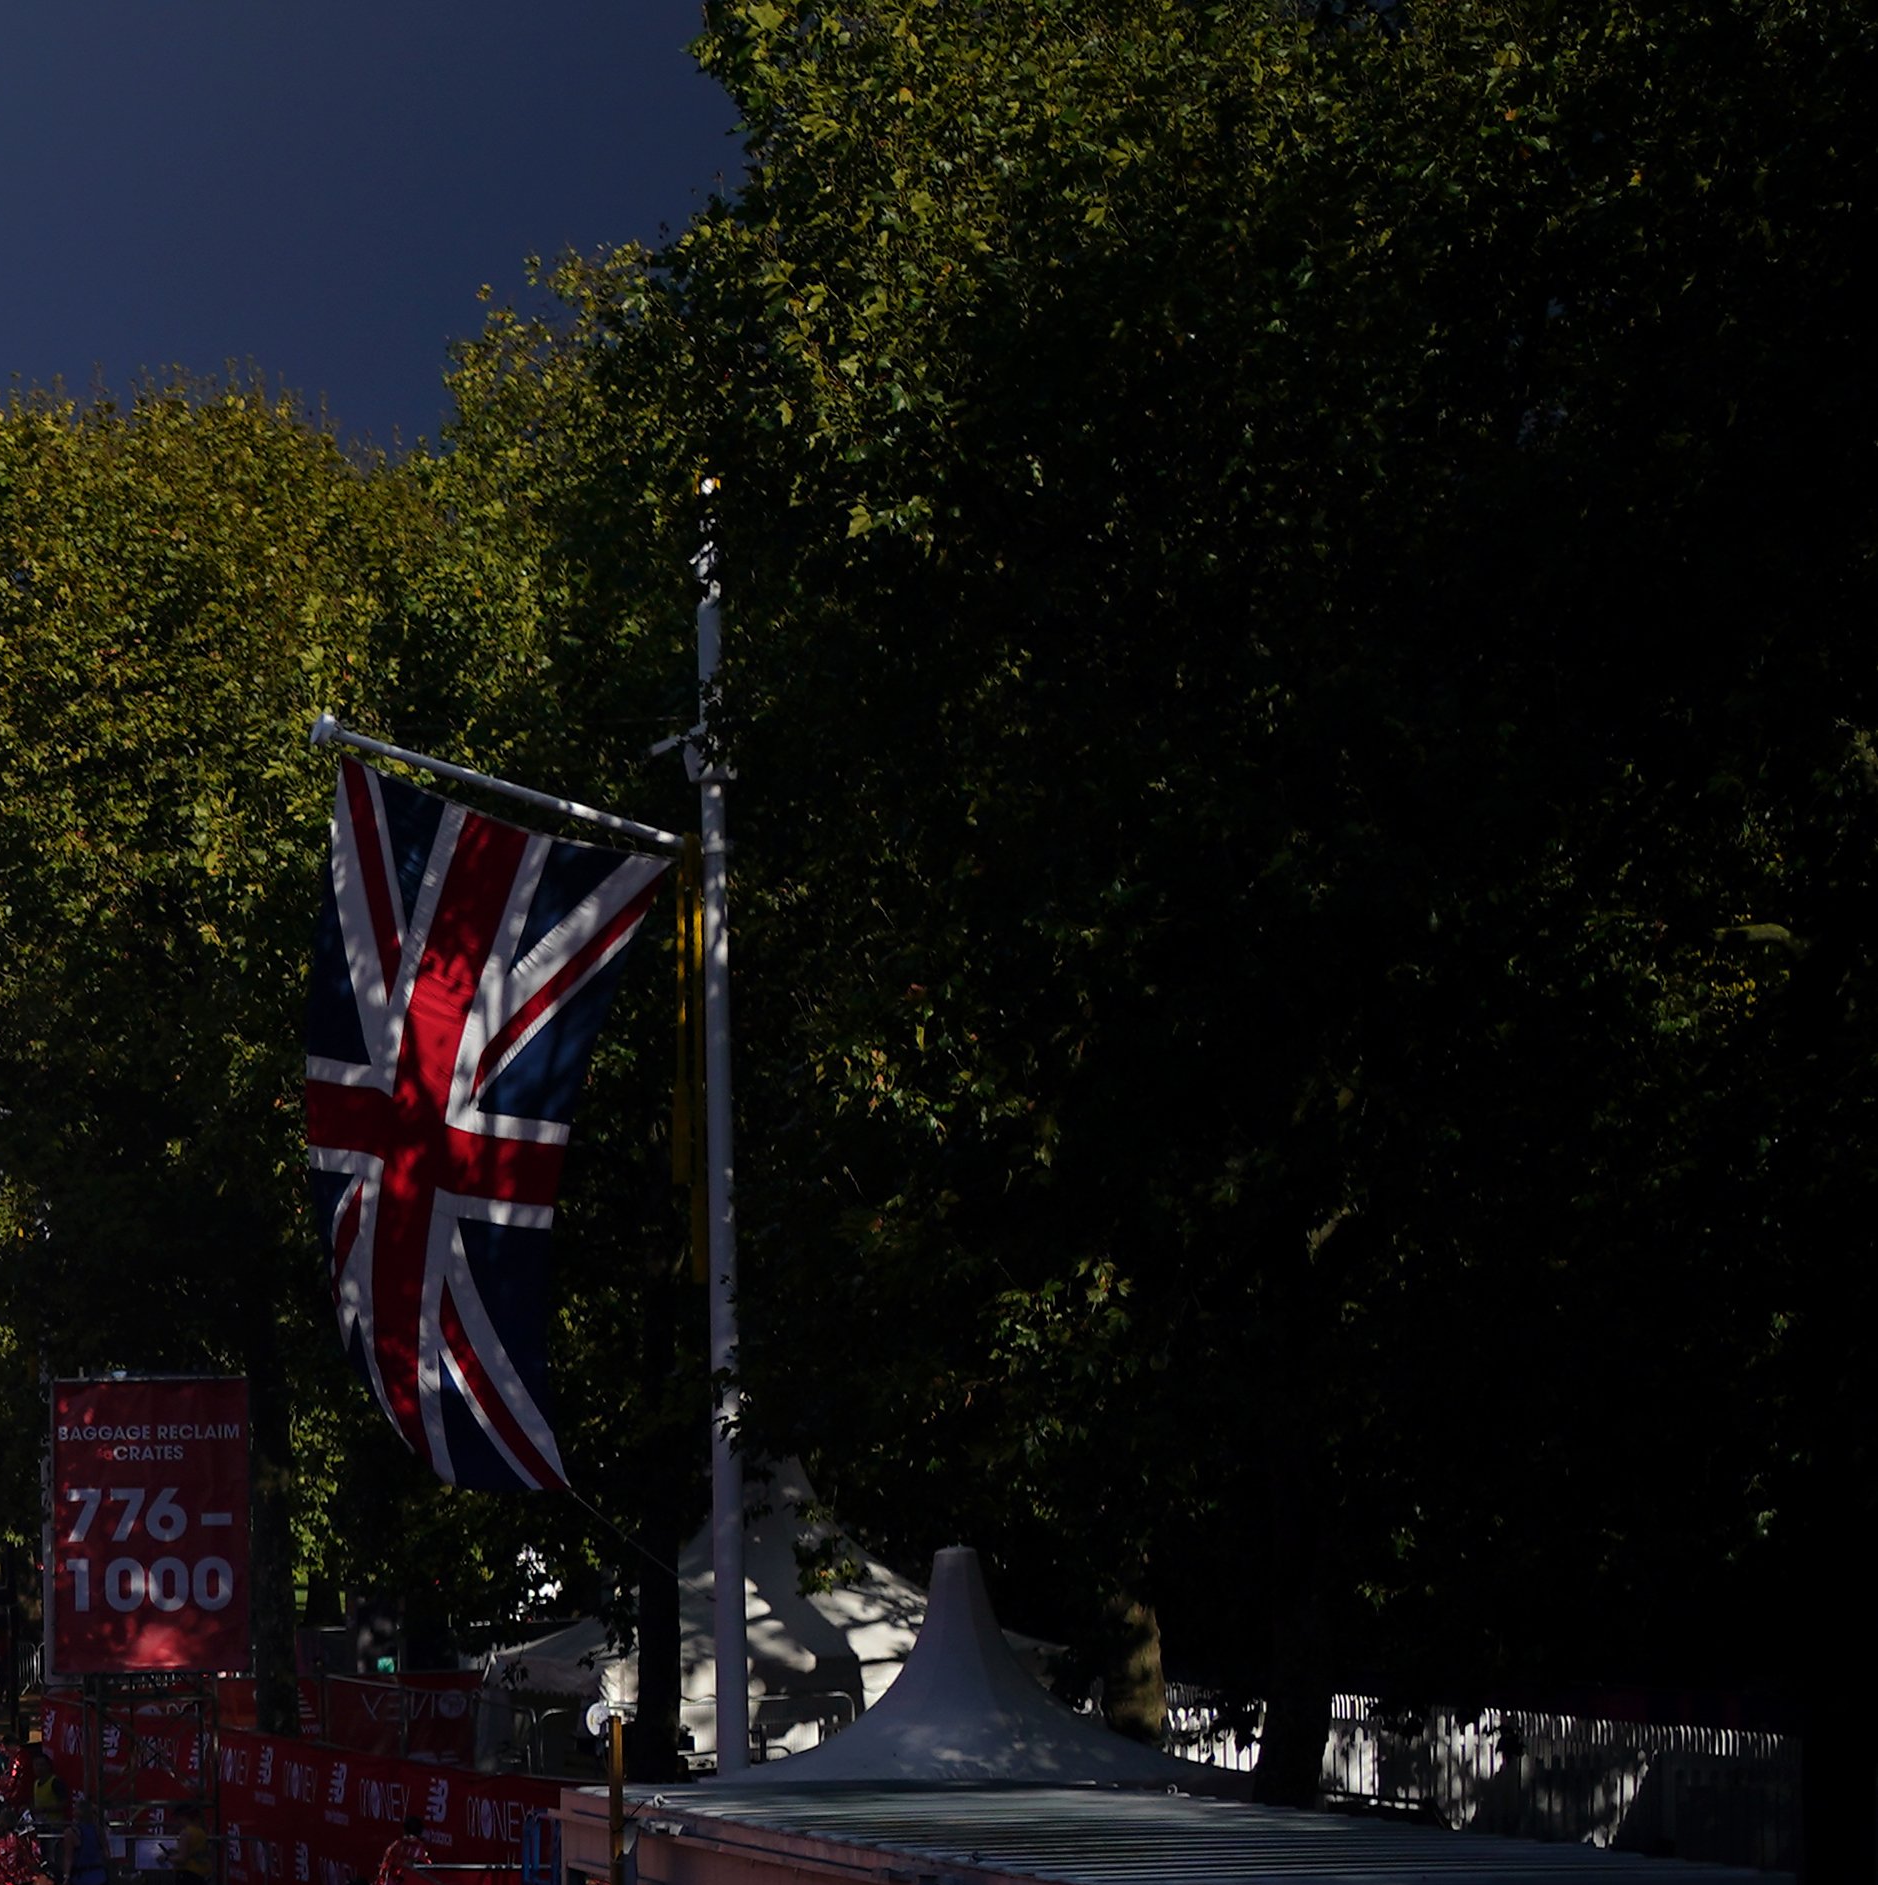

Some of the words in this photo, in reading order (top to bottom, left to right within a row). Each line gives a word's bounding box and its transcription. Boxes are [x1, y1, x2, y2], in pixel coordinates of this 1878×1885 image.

[58, 1426, 151, 1442] BAGGAGE
[157, 1424, 240, 1439] RECLAIM
[113, 1445, 184, 1461] CRATES
[67, 1487, 188, 1543] 776
[66, 1555, 234, 1613] 1000
